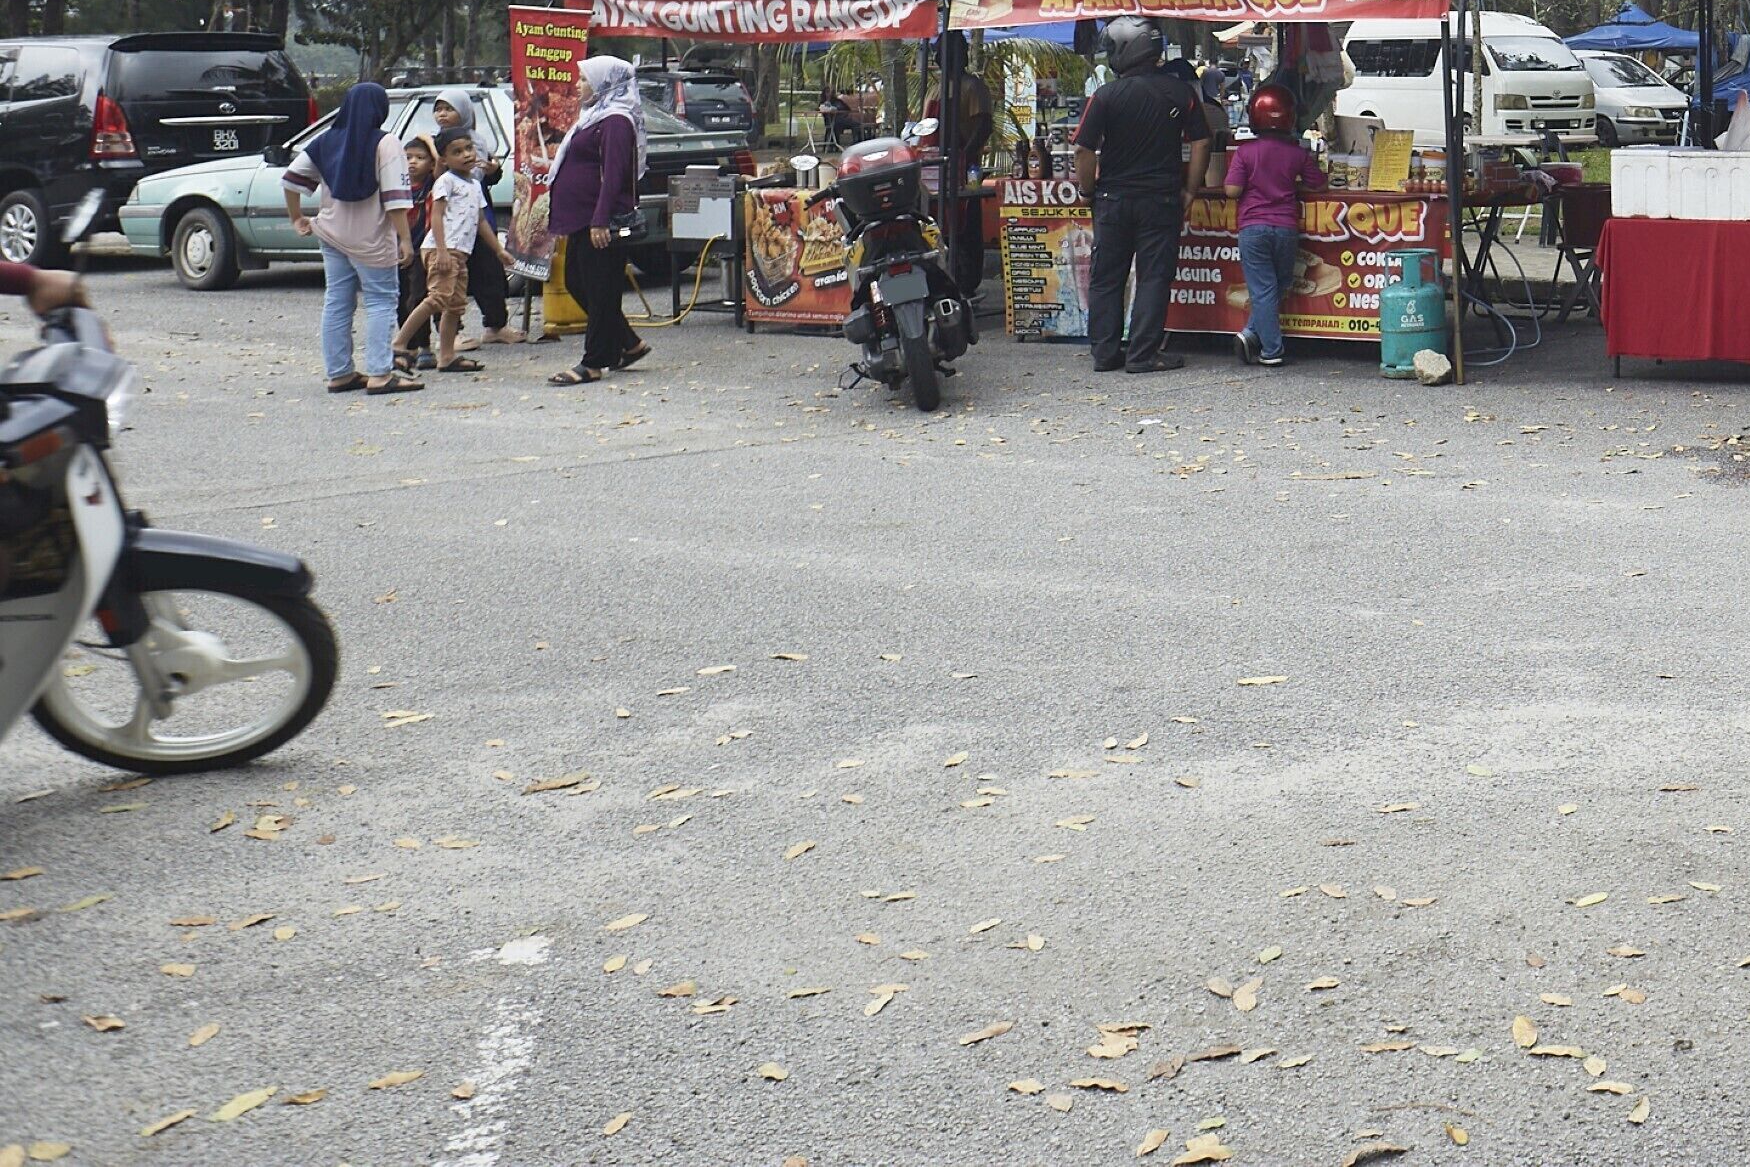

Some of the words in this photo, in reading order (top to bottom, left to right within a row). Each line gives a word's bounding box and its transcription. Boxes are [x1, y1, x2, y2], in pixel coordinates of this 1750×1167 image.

[658, 0, 788, 33] GUNTING
[515, 21, 544, 37] Ayam
[545, 23, 587, 42] Gunting
[526, 44, 573, 62] Ranggup
[525, 65, 545, 80] Kak
[548, 67, 572, 82] Ross
[1005, 180, 1038, 204] AIS
[1041, 180, 1081, 204] KO
[1021, 208, 1063, 216] SEJUK
[1347, 201, 1424, 239] QUE
[1400, 314, 1424, 323] GAS
